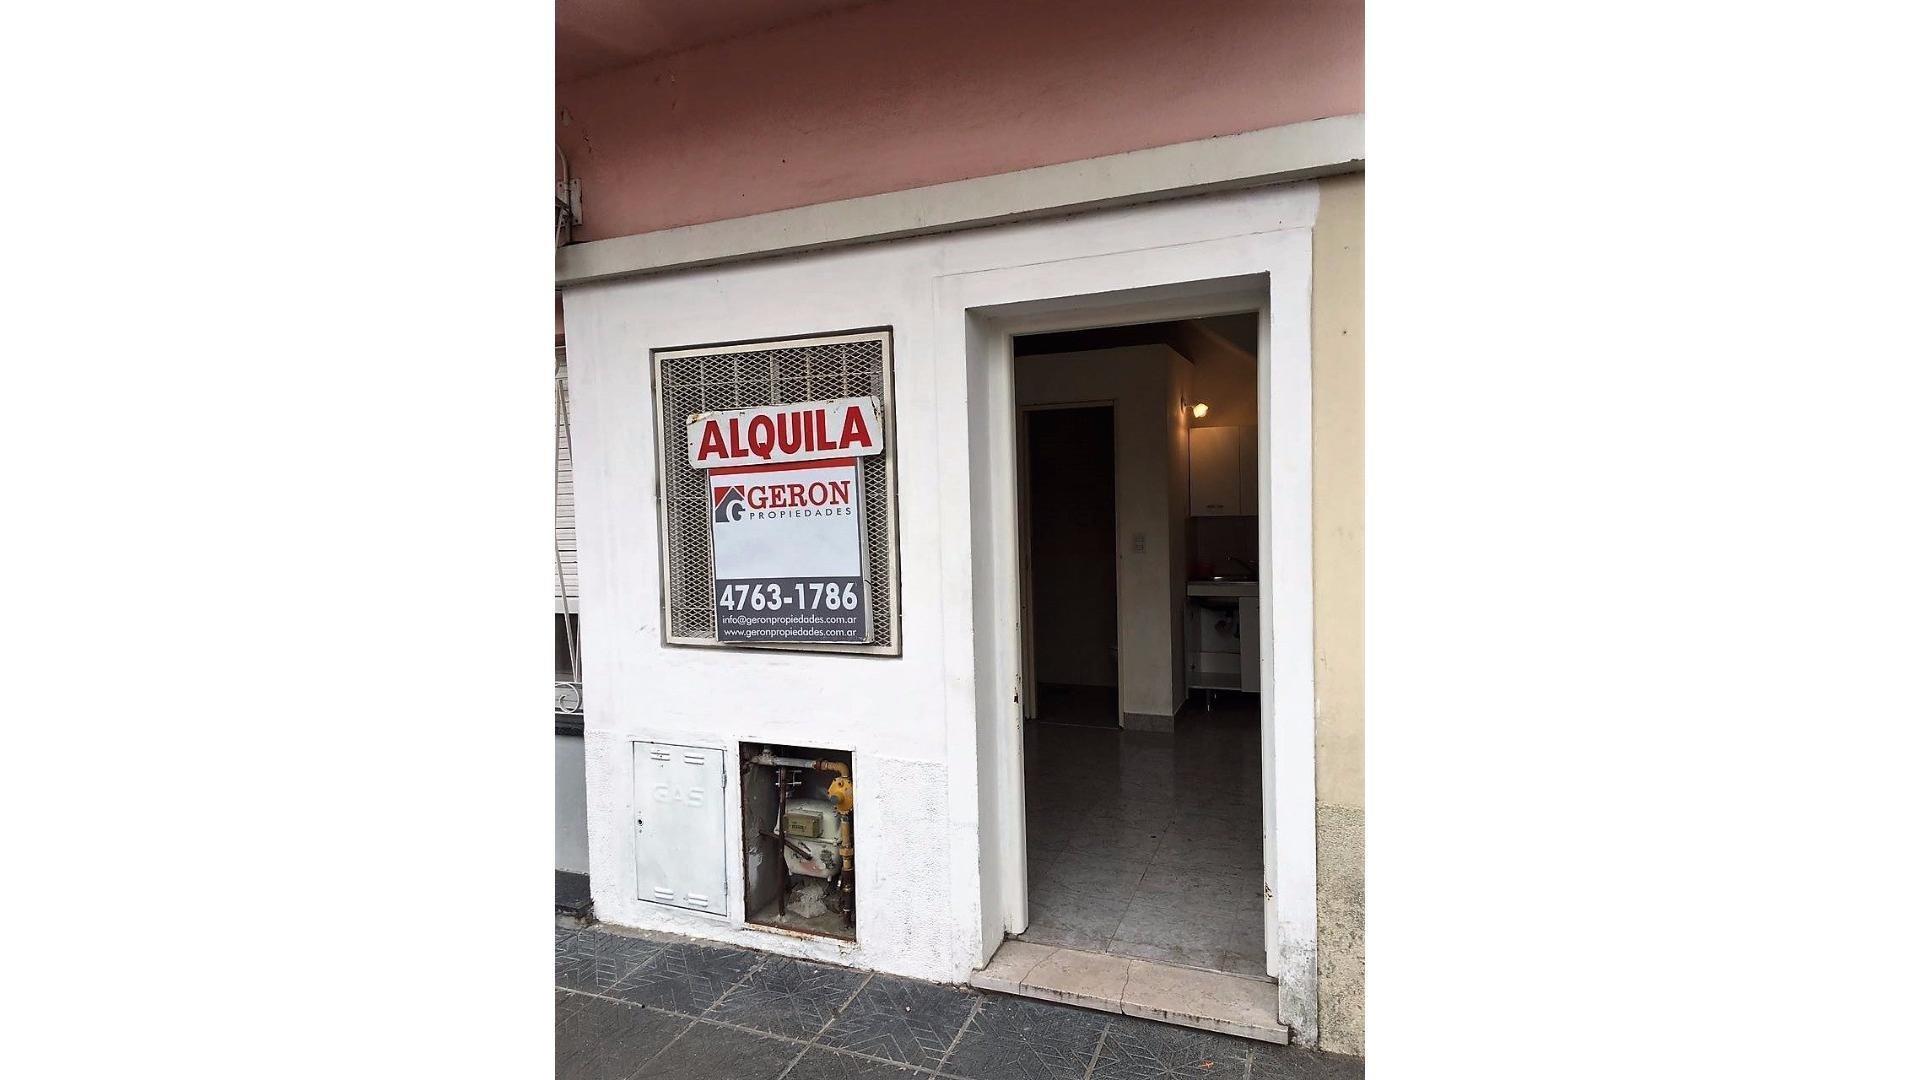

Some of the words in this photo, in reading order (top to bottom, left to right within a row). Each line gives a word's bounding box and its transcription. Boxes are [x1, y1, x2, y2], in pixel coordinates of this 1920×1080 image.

[697, 405, 872, 461] ALQUILA
[747, 480, 851, 509] GERON
[749, 507, 852, 520] PROPIEDADES
[719, 582, 858, 611] 4763-1786
[722, 614, 857, 626] info@geronpropiedades.com.ar
[724, 626, 857, 638] www.geronpropiedades.com.ar
[654, 786, 704, 808] GAS
